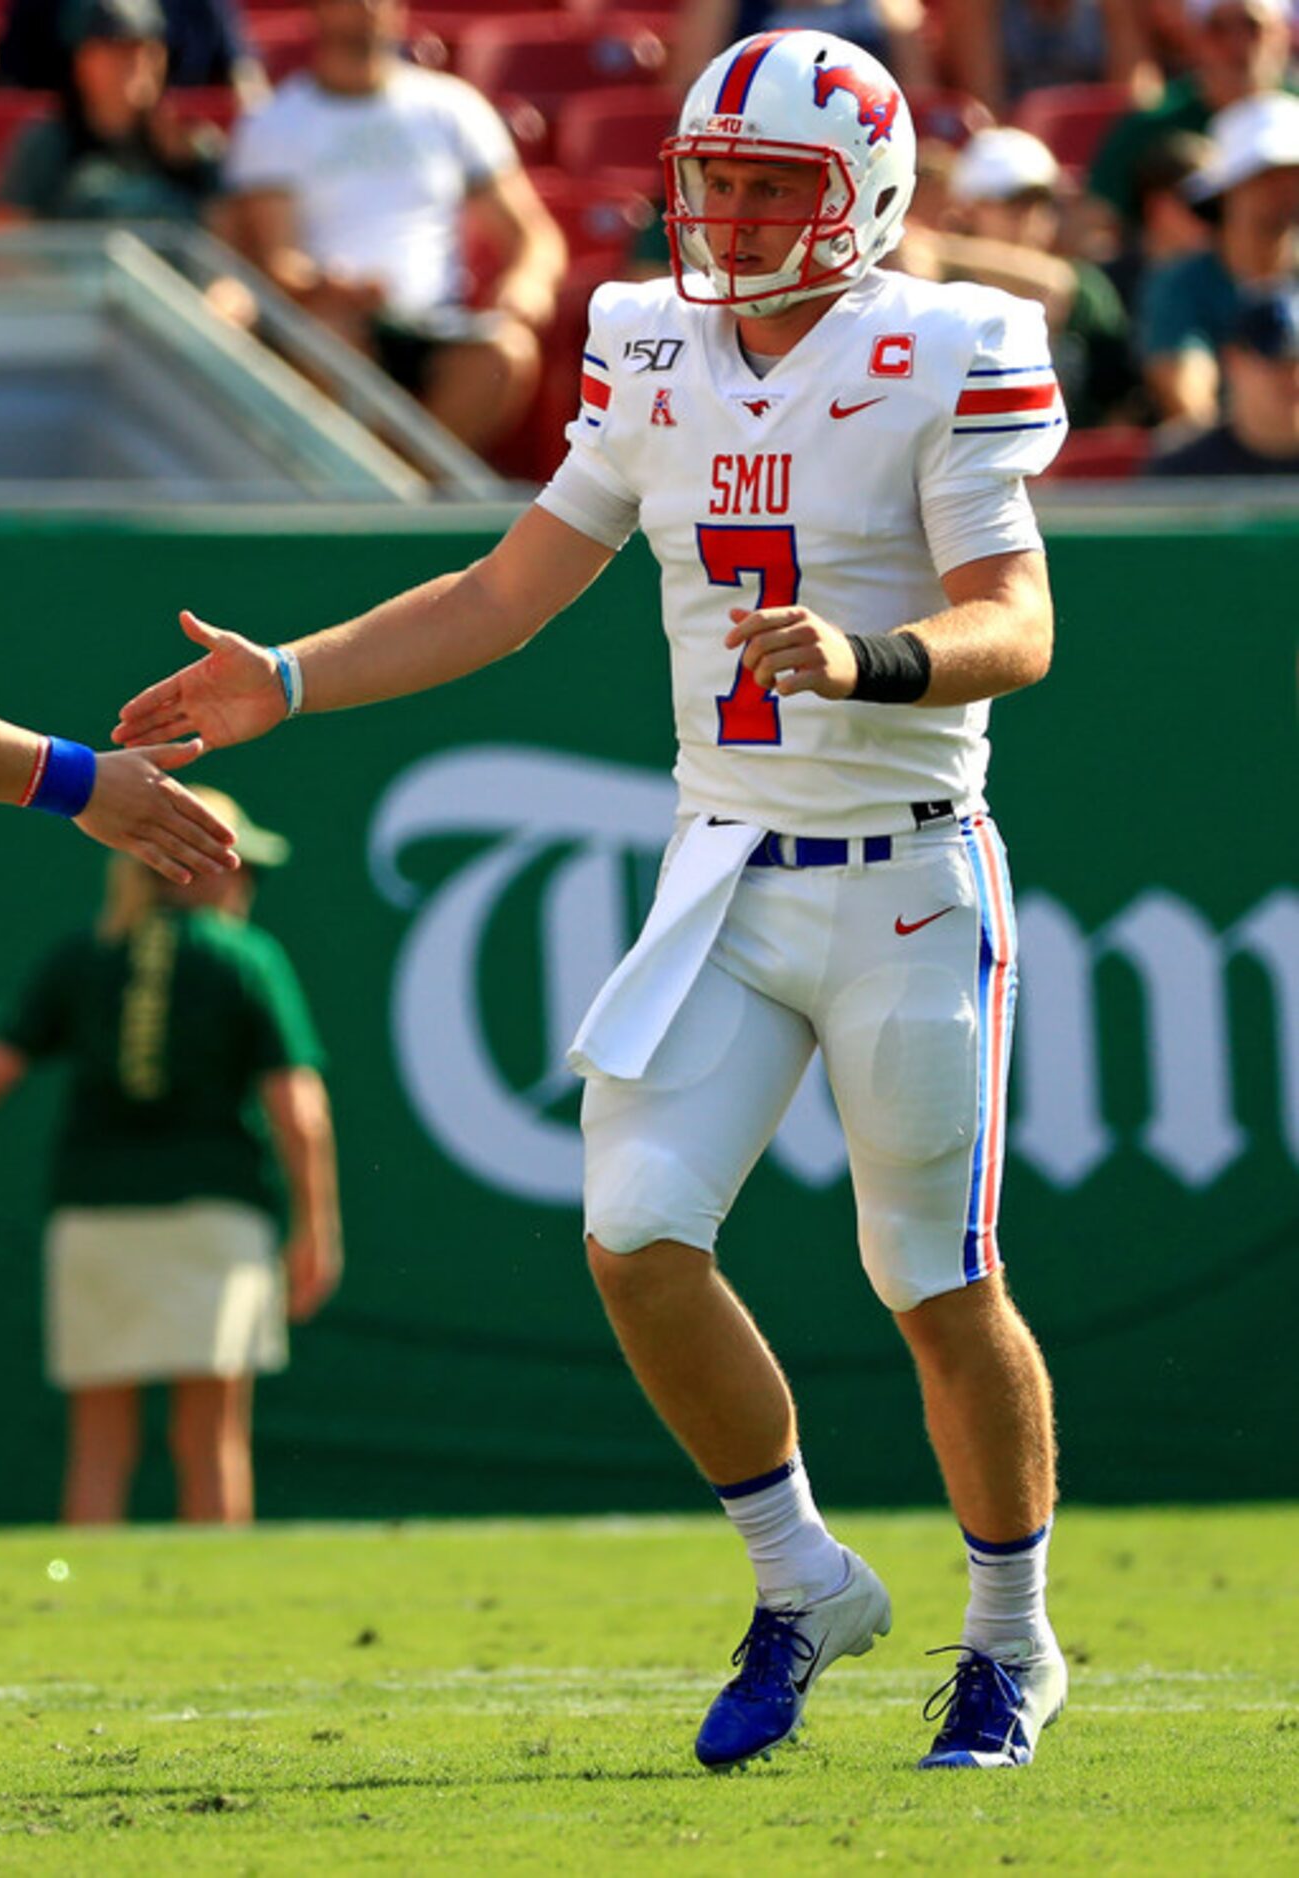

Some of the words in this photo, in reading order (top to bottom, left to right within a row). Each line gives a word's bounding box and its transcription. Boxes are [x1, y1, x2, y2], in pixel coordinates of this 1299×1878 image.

[869, 334, 914, 377] C
[709, 453, 793, 515] SMU
[695, 523, 801, 746] 7
